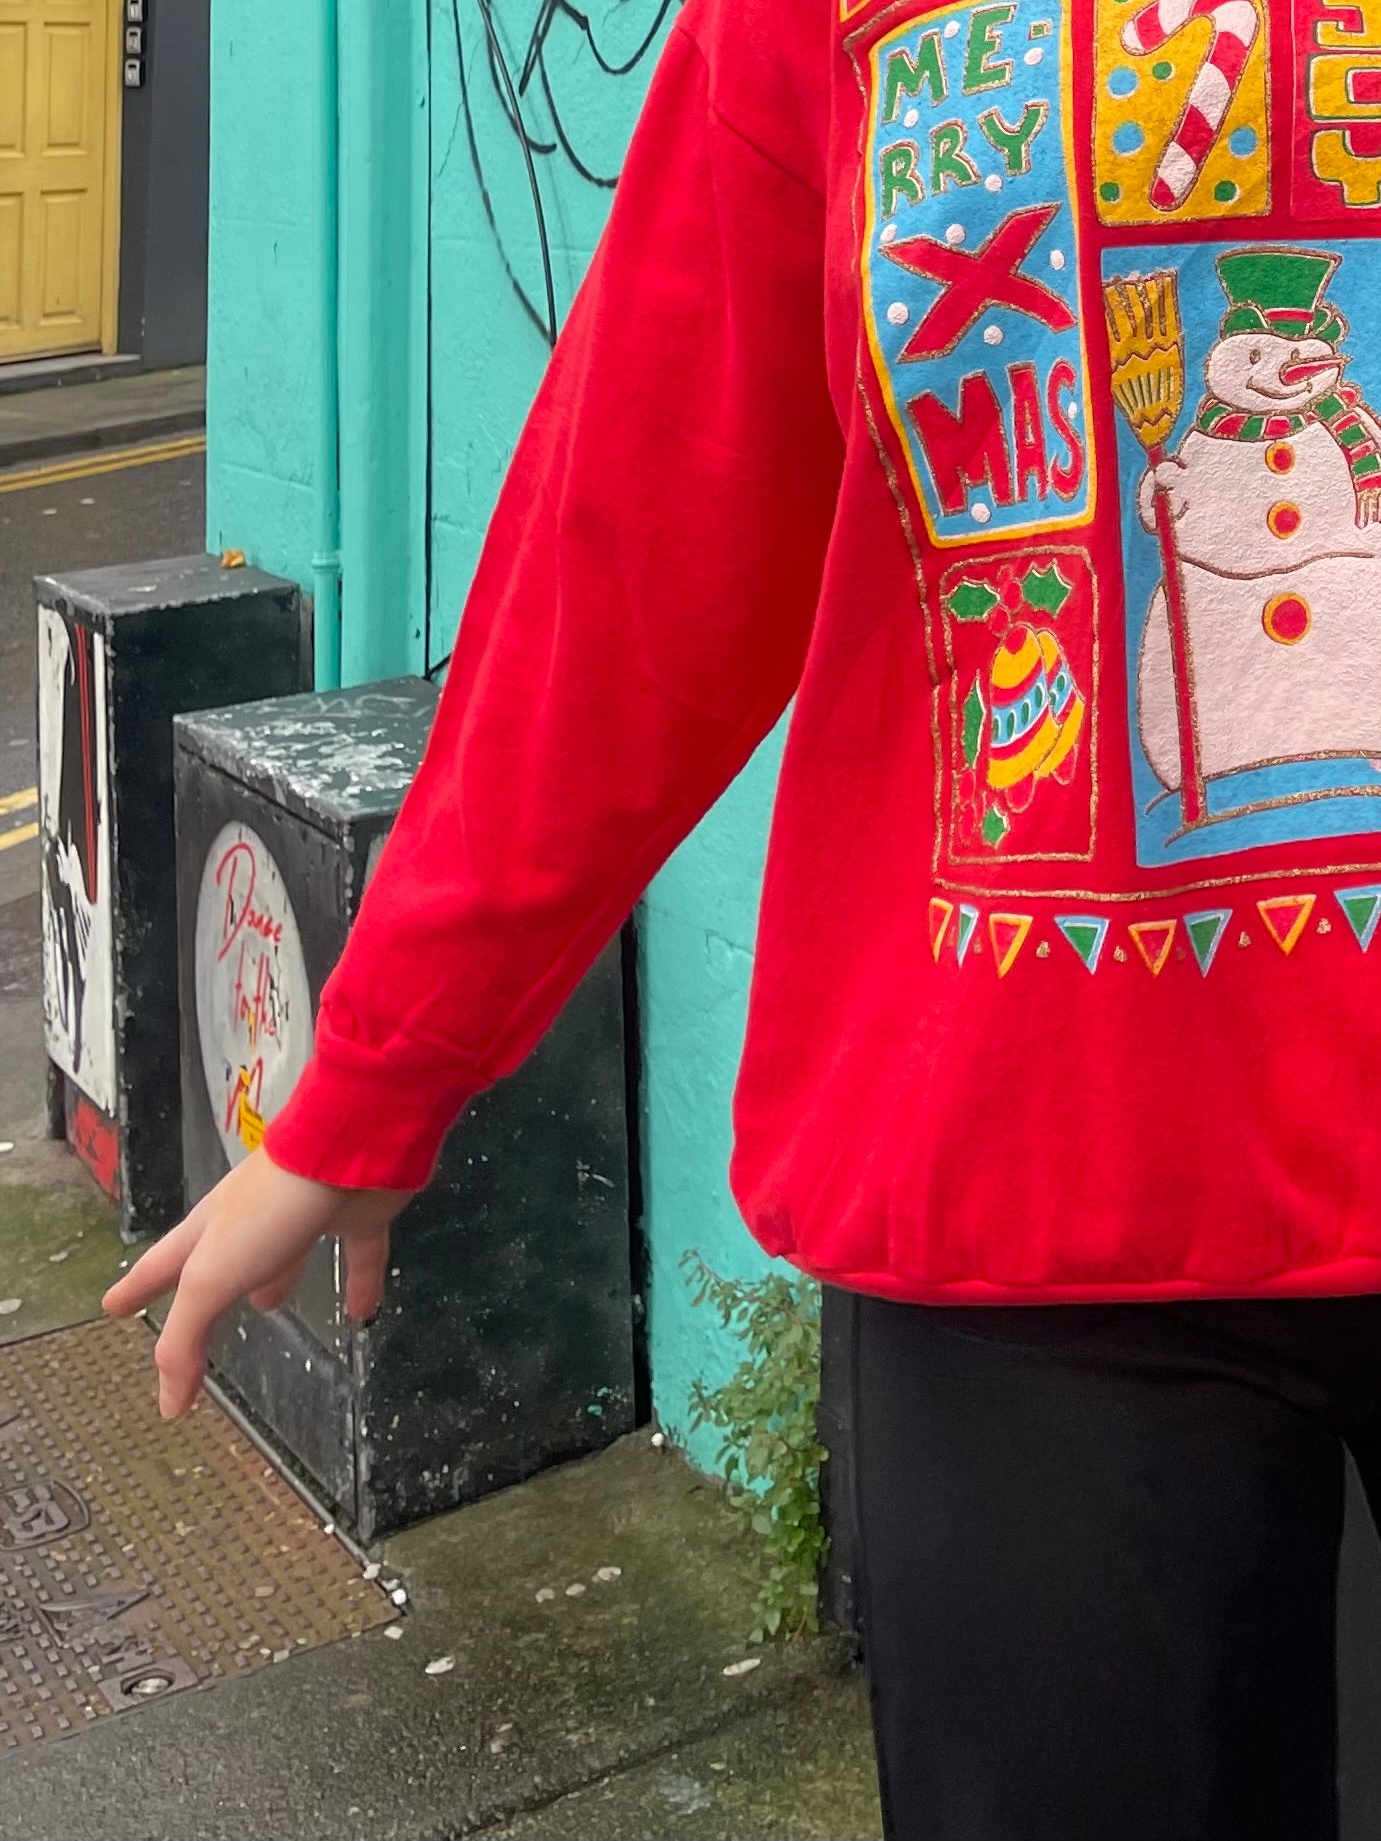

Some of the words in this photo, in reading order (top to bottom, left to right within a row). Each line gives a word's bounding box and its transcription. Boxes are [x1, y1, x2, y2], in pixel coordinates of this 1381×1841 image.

[879, 99, 1050, 222] RRY
[876, 200, 1078, 364] X
[905, 358, 1086, 517] MAS
